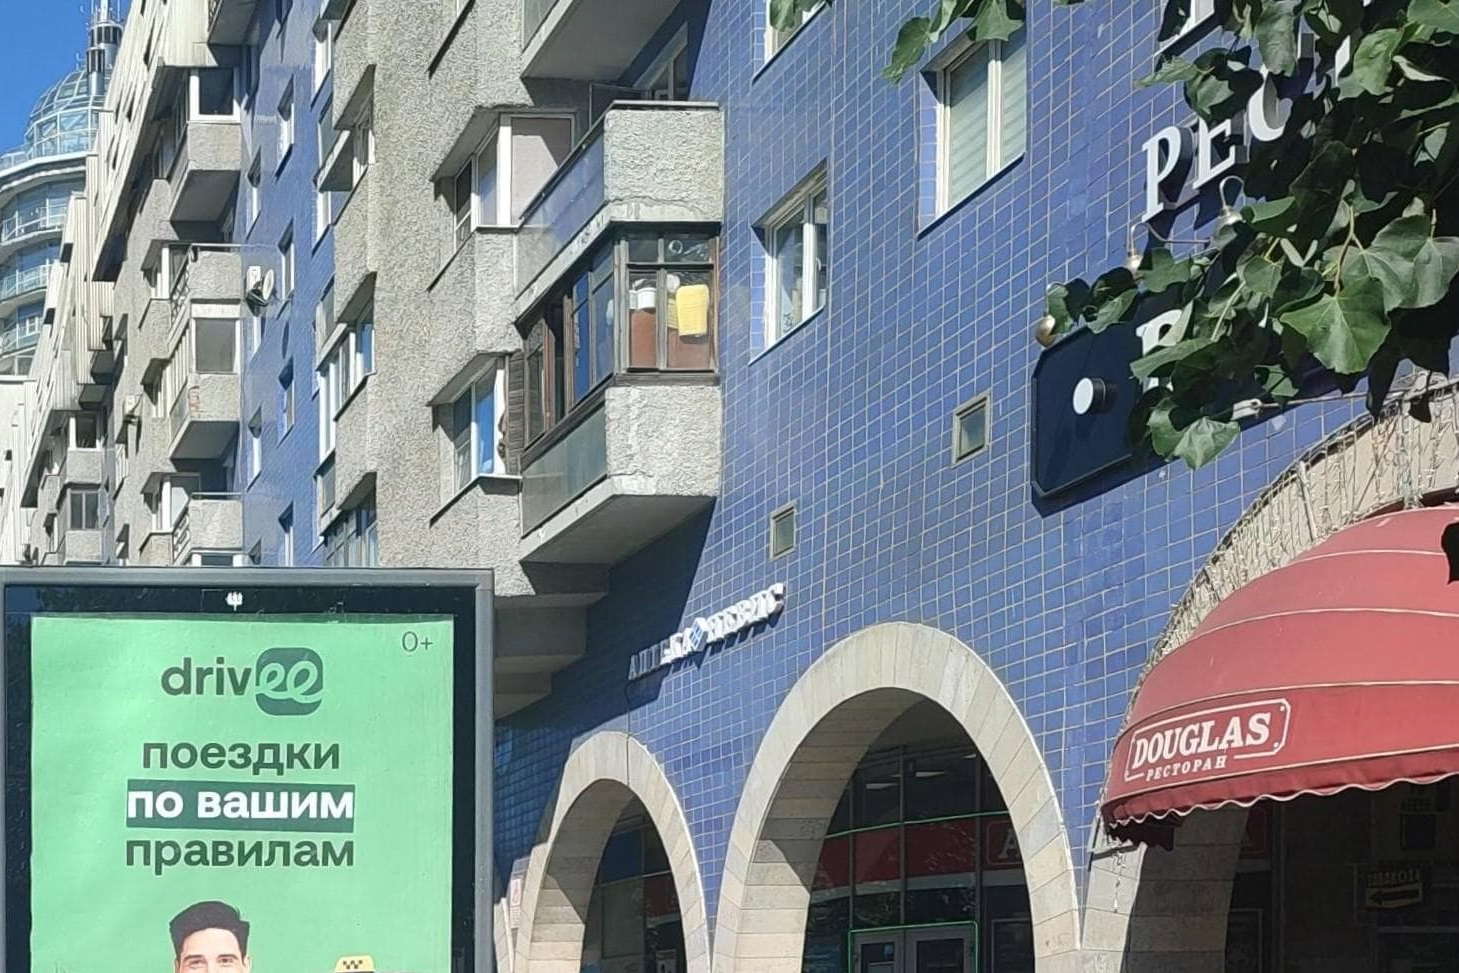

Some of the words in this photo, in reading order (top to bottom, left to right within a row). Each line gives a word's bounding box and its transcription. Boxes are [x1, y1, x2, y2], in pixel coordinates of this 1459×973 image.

[401, 630, 434, 652] 0+
[160, 647, 324, 715] drivee
[1131, 711, 1272, 770] DOUGLAS
[142, 741, 340, 776] поездки
[1145, 755, 1228, 782] РЕСТОРАН
[127, 788, 184, 819] по
[197, 790, 354, 820] вашим
[126, 839, 354, 876] правилам
